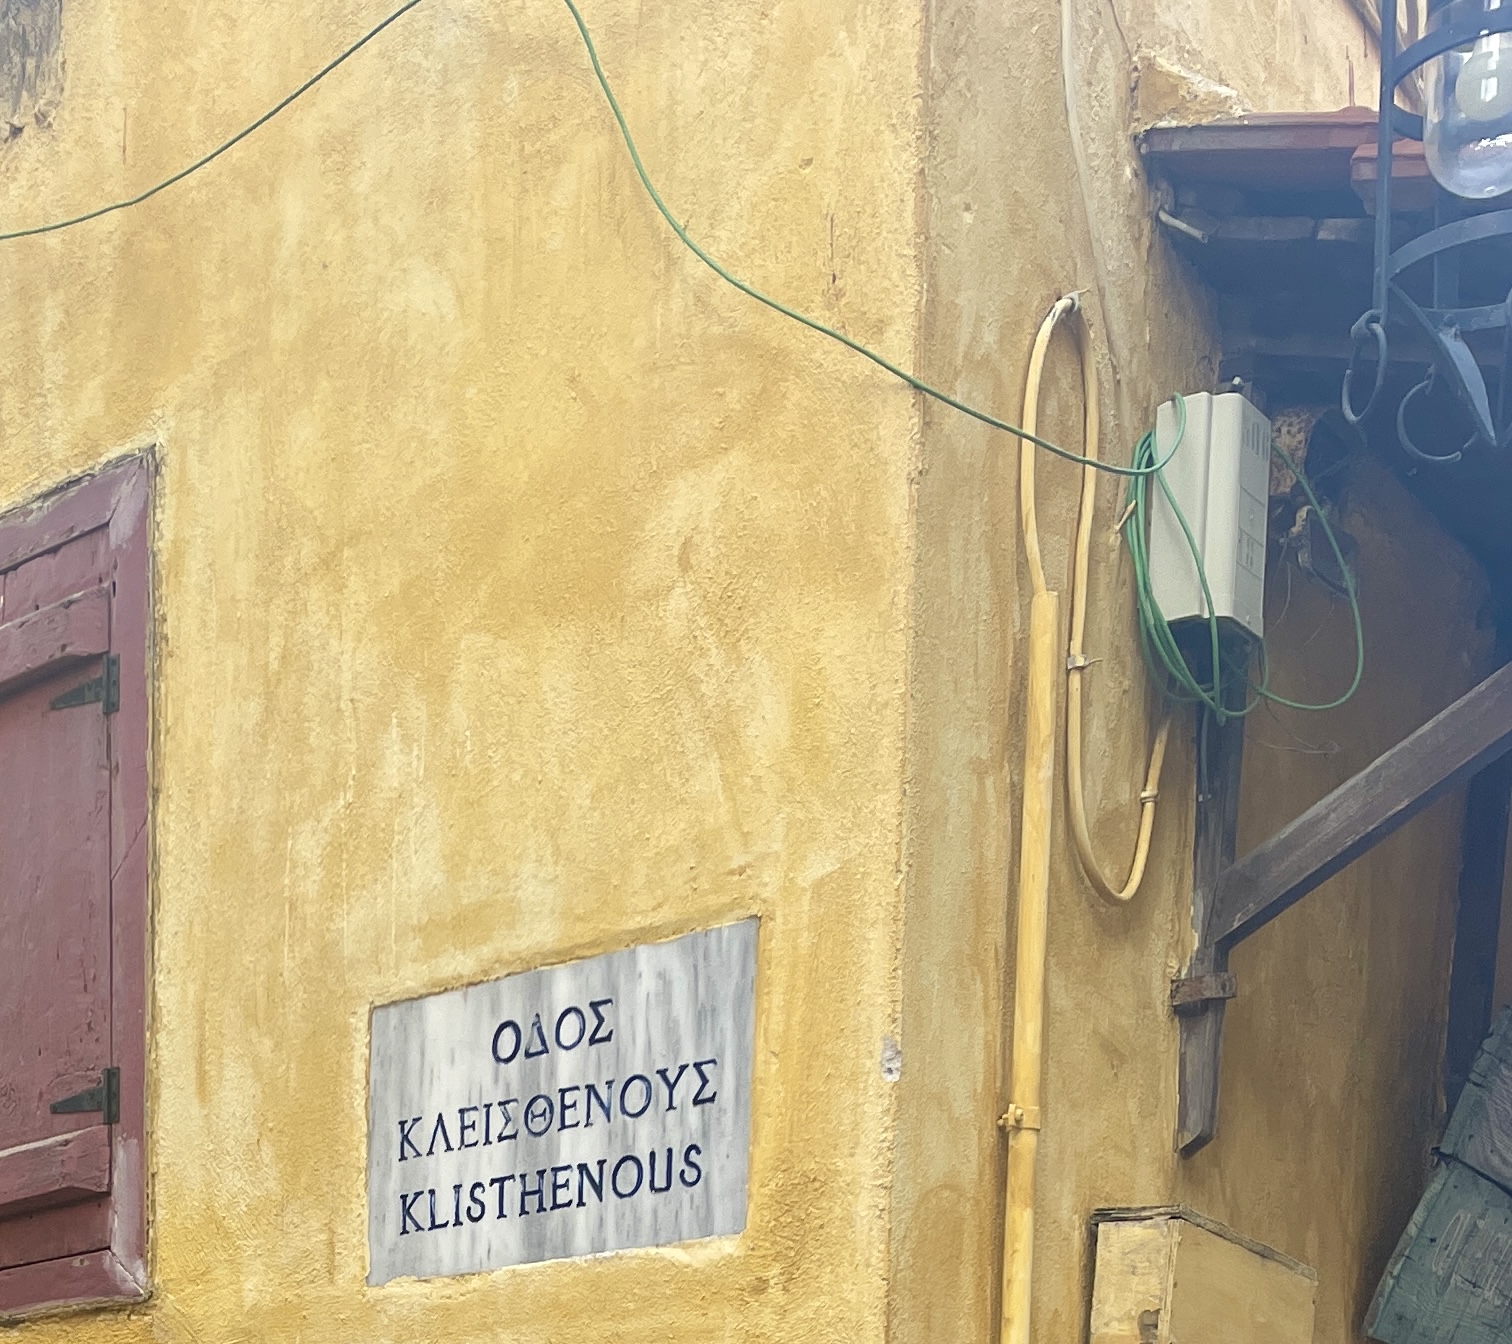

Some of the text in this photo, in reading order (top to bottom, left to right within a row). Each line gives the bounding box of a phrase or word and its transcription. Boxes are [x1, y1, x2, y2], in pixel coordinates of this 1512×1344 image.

[491, 998, 614, 1064] ΟΔΟΣ
[398, 1058, 718, 1162] ΚΛΕΙΣΘΕΝΟΥΣ
[399, 1143, 703, 1236] KLISTHENOUS
